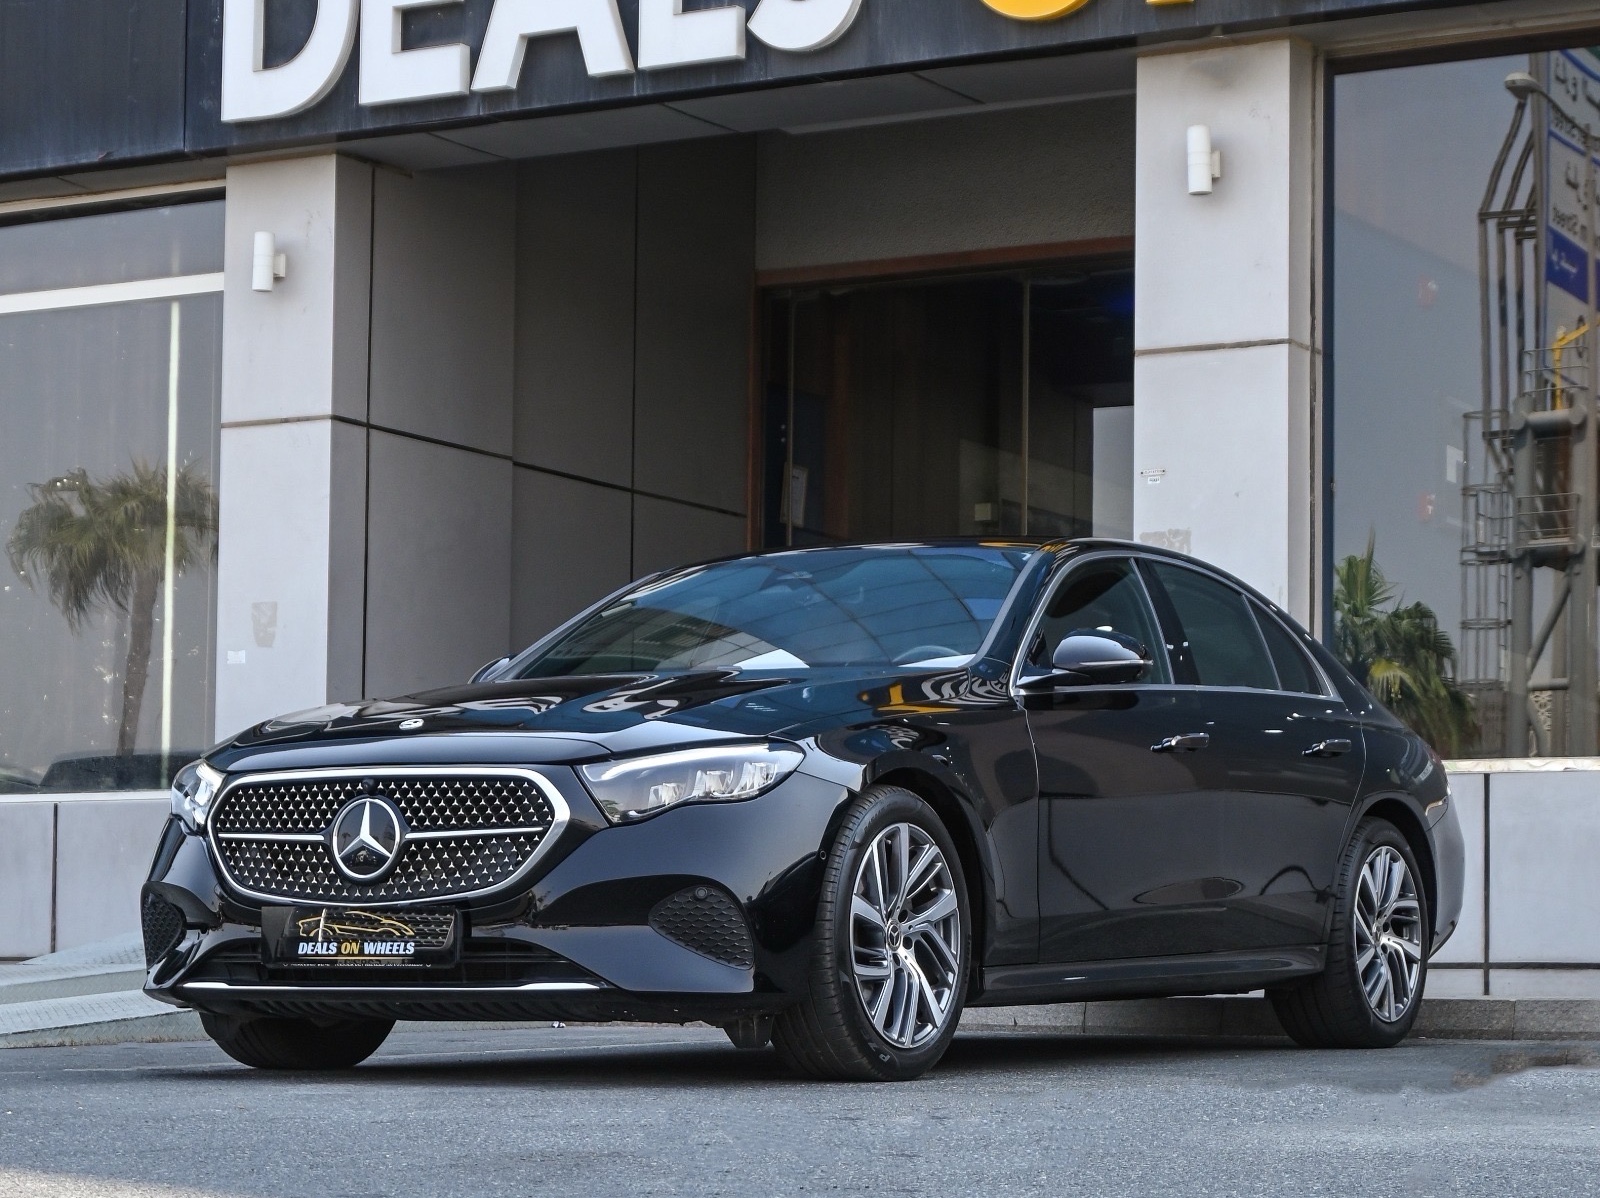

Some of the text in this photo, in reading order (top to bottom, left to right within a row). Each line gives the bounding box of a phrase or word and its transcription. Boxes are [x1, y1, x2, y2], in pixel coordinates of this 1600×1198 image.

[298, 942, 415, 955] DEALS ON WHEELS
